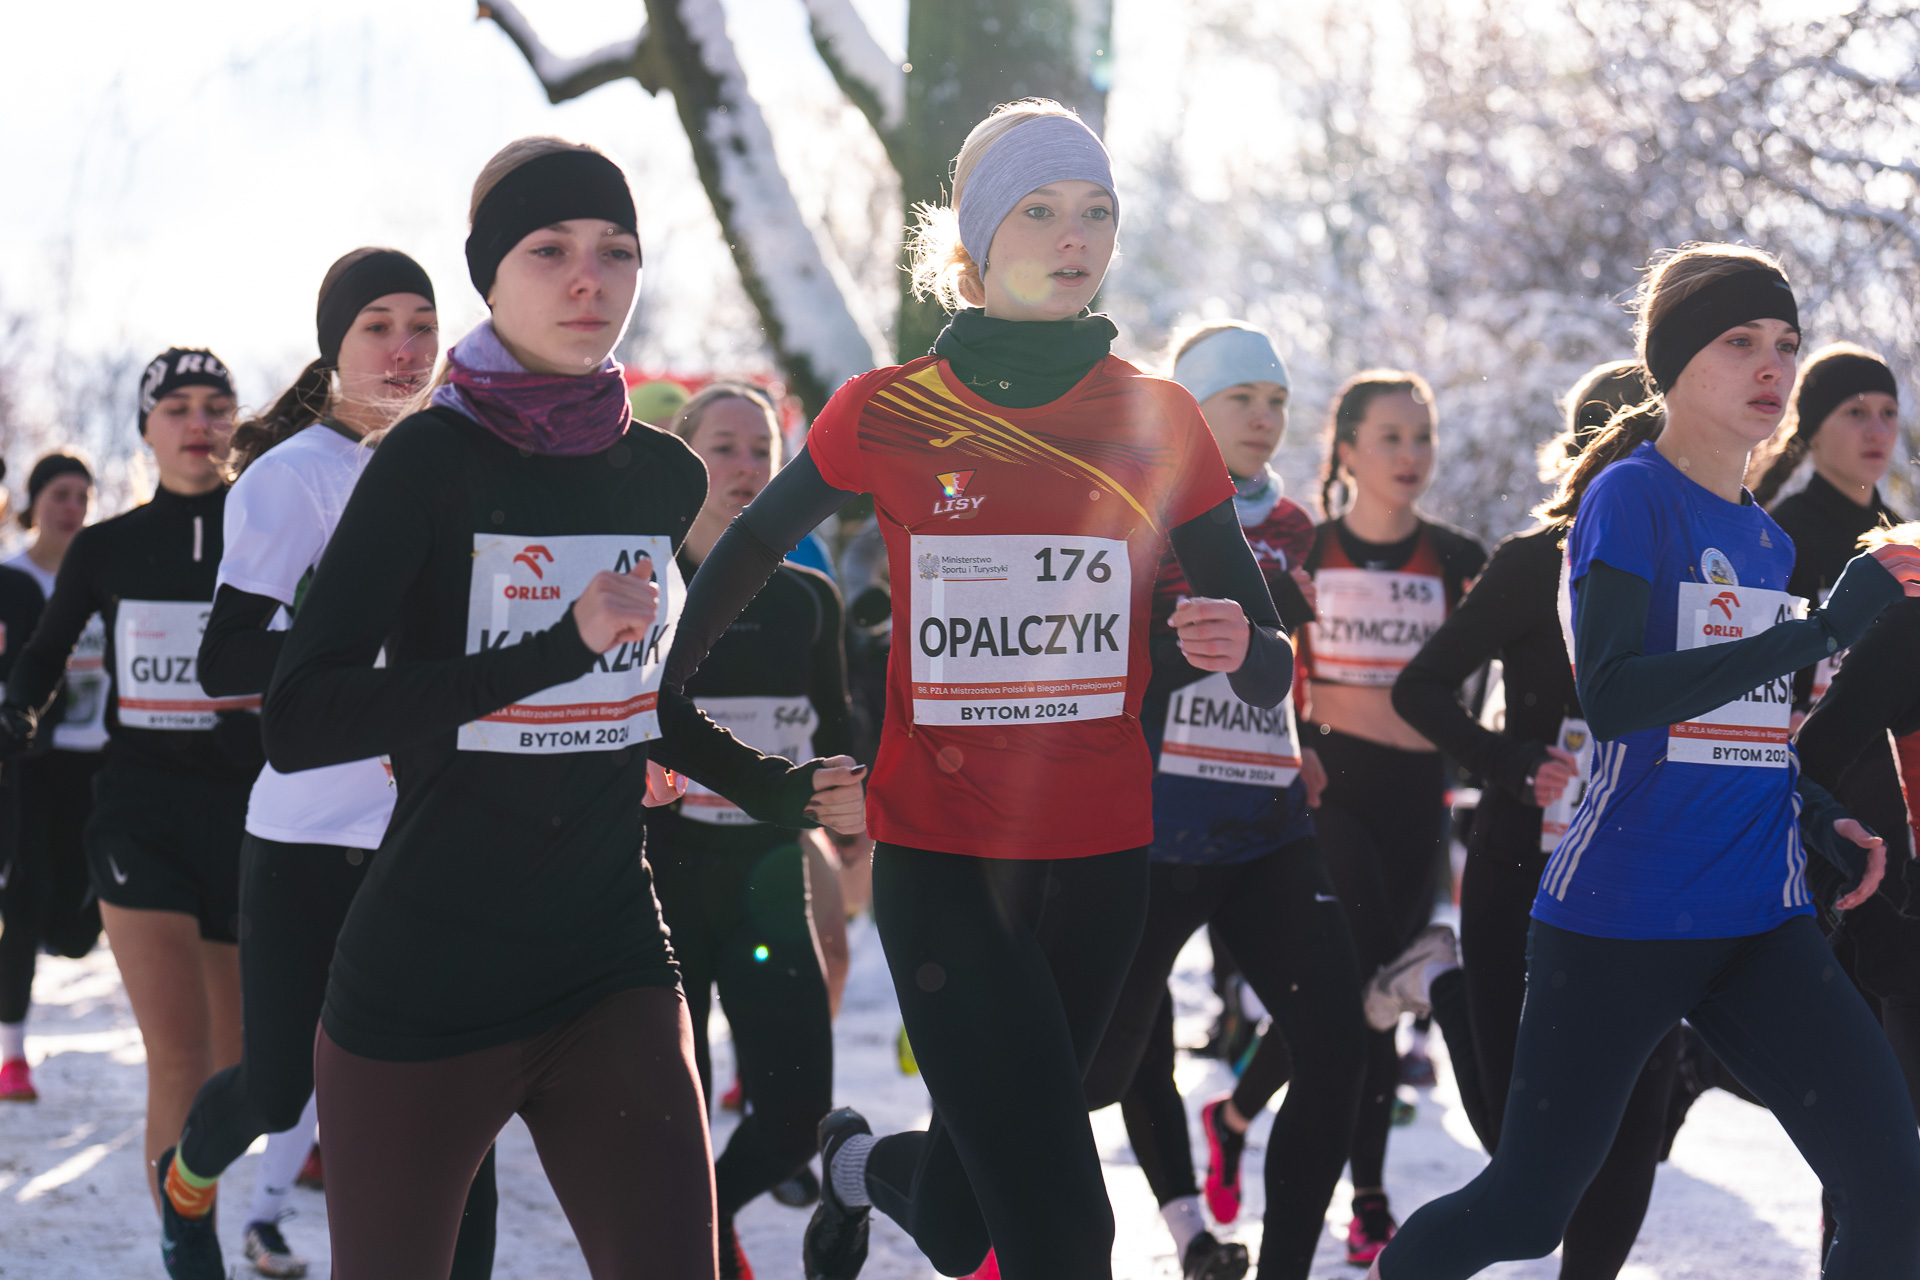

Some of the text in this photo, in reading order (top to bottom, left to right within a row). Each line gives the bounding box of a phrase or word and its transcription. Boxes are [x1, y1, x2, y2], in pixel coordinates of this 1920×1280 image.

[933, 496, 985, 514] LISY
[941, 556, 992, 564] Ministerstwo
[1034, 547, 1112, 583] 176
[941, 565, 967, 574] Sportu
[973, 564, 1009, 574] Turystyki
[504, 584, 561, 600] ORLEN
[1391, 581, 1433, 603] 145
[919, 612, 1121, 658] OPALCZYK
[1703, 623, 1743, 638] ORLEN
[131, 656, 194, 683] GUZ
[917, 686, 929, 694] 96.
[929, 686, 949, 695] PZLA
[950, 686, 1001, 695] Mistrzostwa
[1002, 684, 1027, 694] Polski
[1036, 683, 1071, 694] Biegach
[510, 708, 565, 719] Mistrzostwa
[961, 702, 1079, 721] BYTOM 2024
[1688, 726, 1705, 734] PZLA
[520, 729, 591, 748] BYTOM
[1713, 746, 1787, 763] BYTOM 202
[1198, 764, 1246, 779] BYTOM
